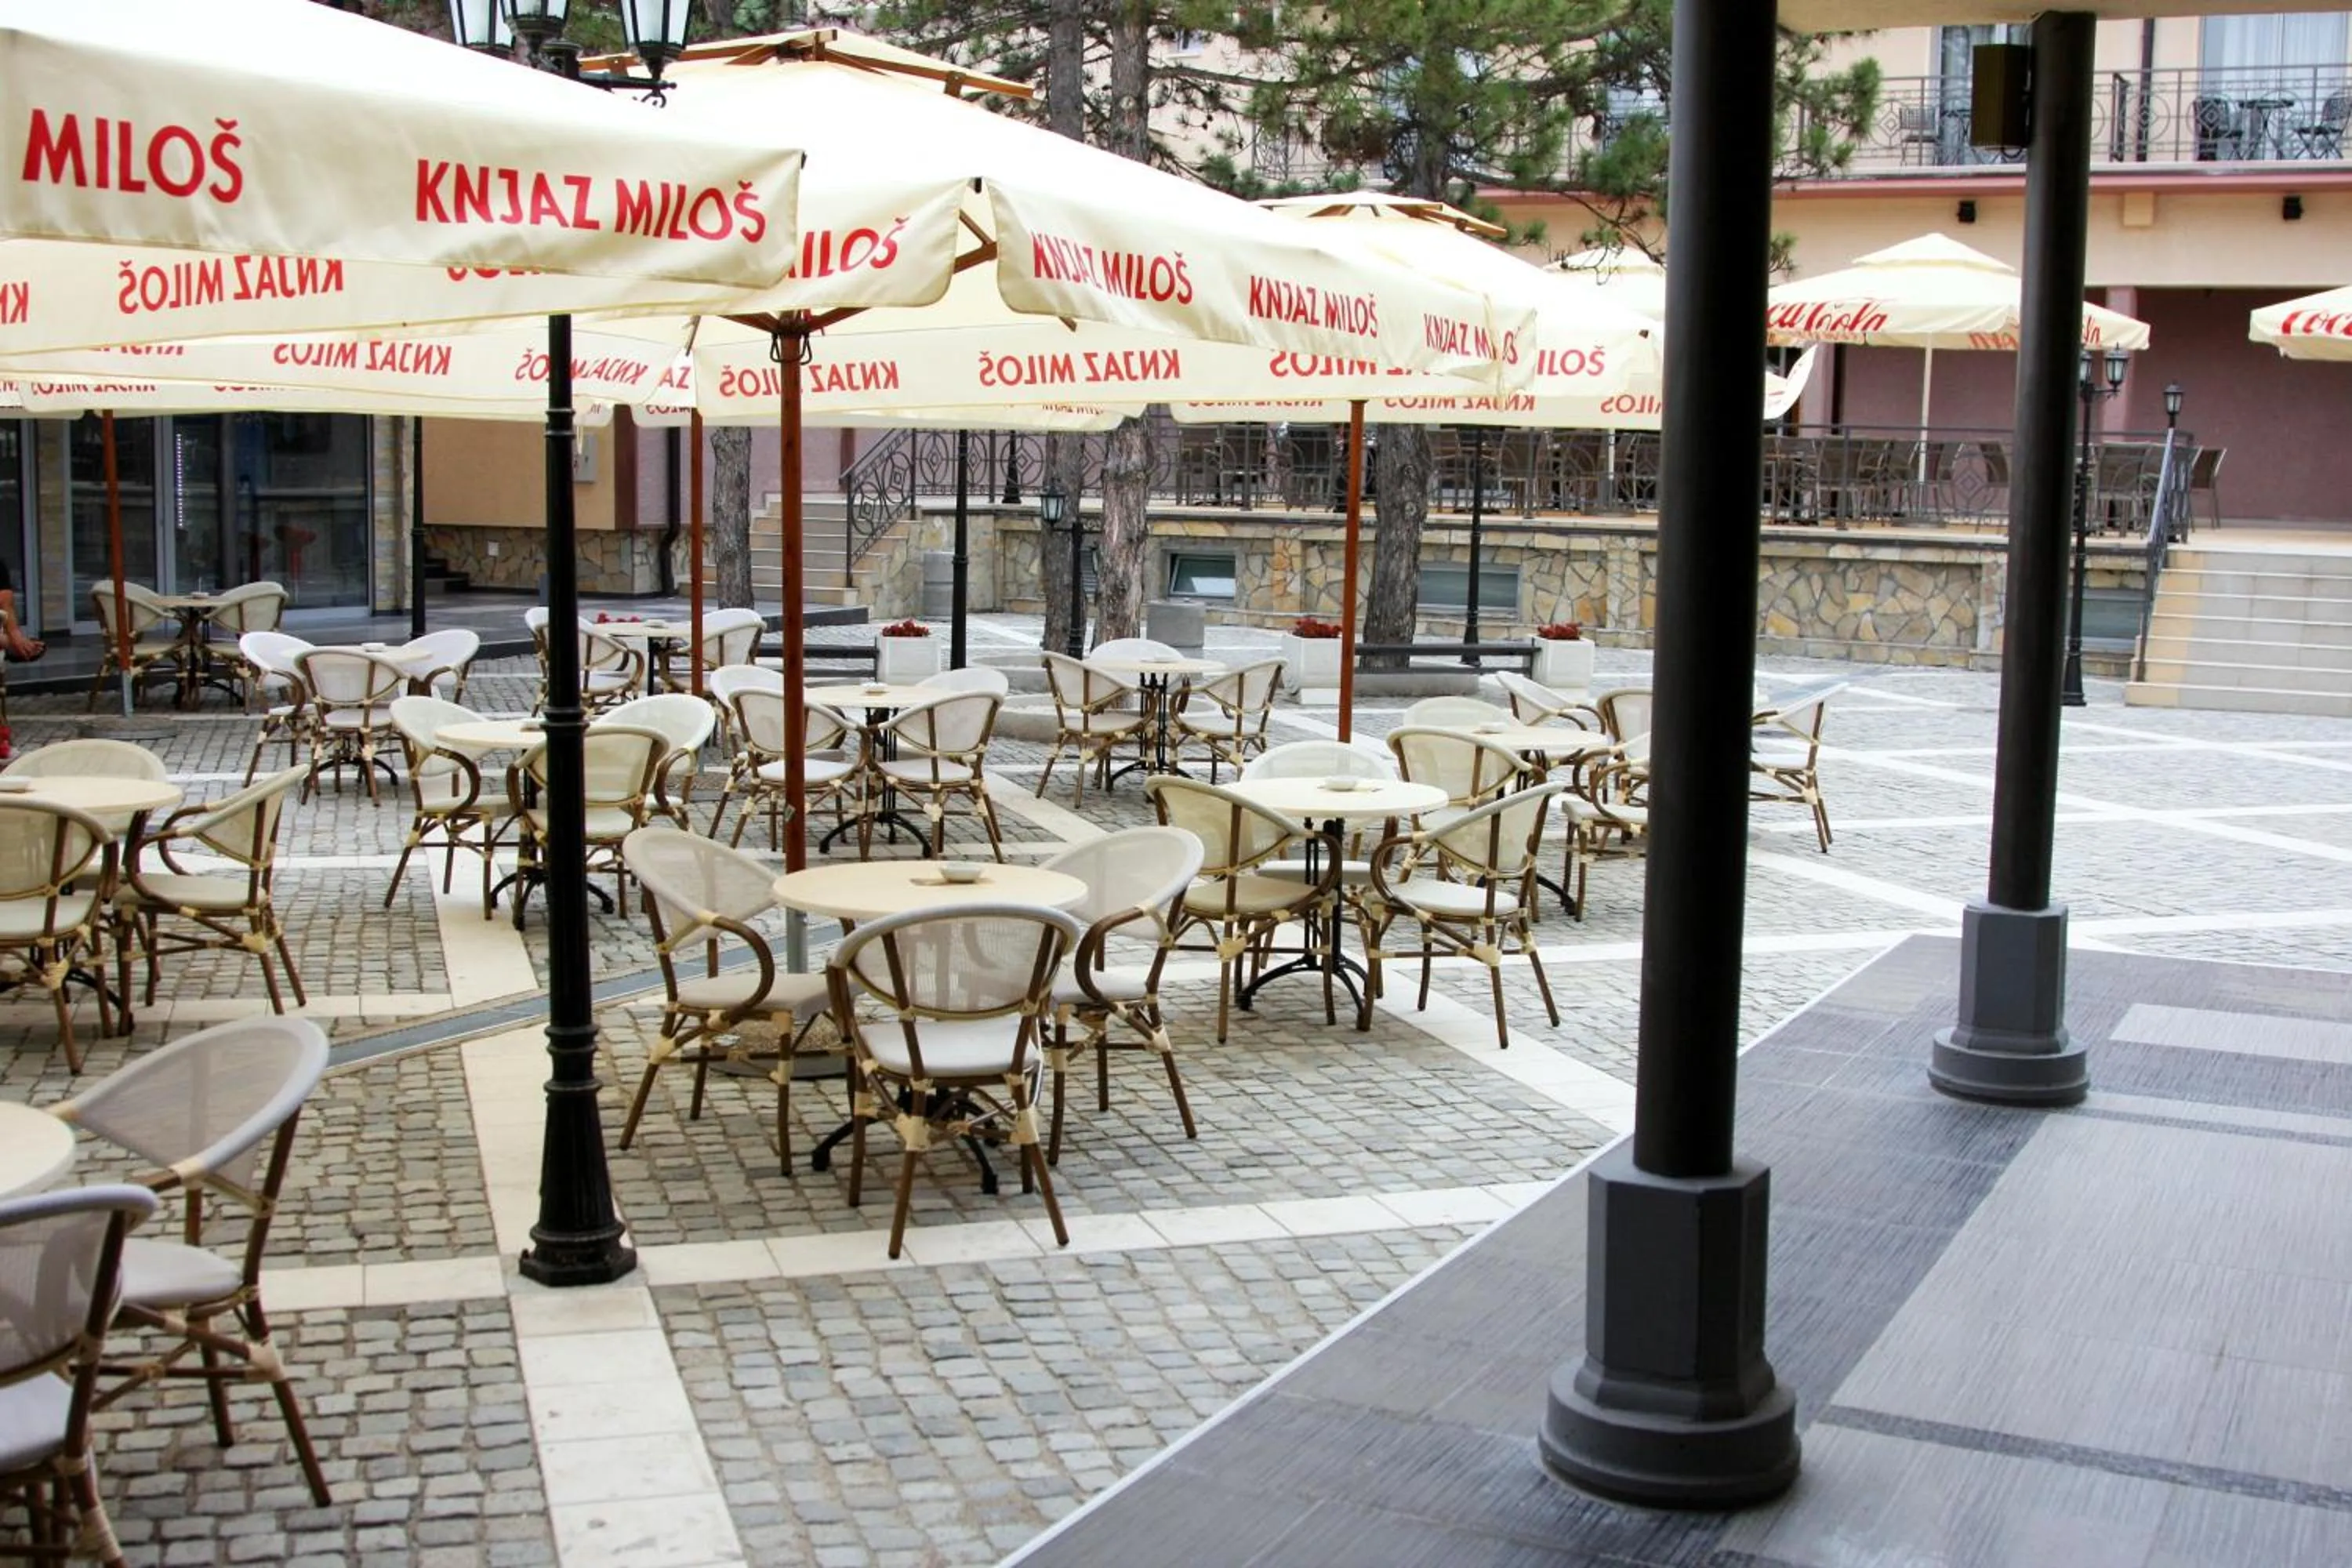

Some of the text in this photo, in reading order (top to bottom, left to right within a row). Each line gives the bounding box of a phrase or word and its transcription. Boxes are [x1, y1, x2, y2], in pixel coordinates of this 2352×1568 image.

[23, 108, 243, 203] MILOŠ
[416, 159, 766, 243] KNJAZ MILOŠ
[788, 216, 909, 278] ILOŠ
[1032, 230, 1192, 305] KNJAZ MILOŠ
[1249, 275, 1378, 339] KNJAZ MILOŠ
[1424, 313, 1471, 356] KNJAZ
[1537, 344, 1606, 376] ILOŠ
